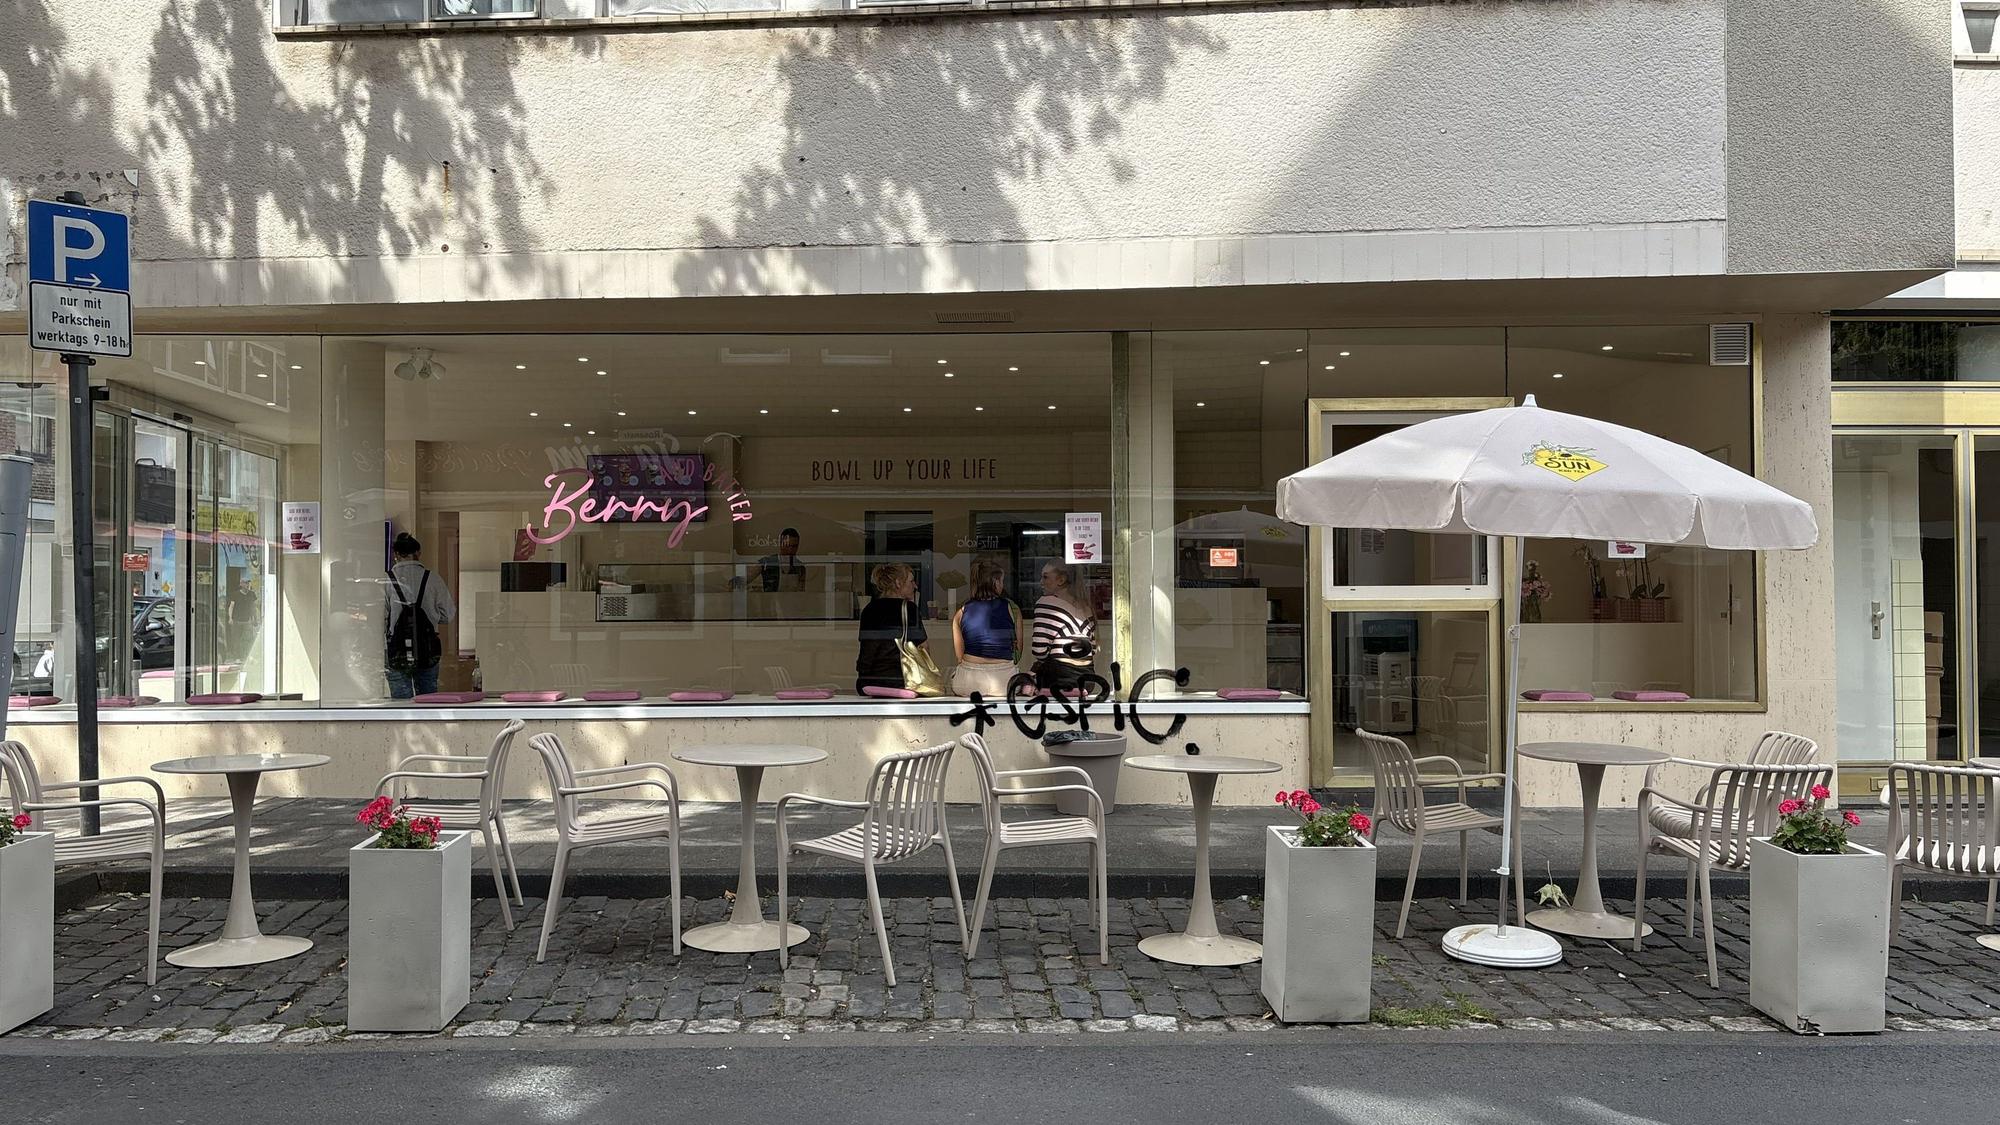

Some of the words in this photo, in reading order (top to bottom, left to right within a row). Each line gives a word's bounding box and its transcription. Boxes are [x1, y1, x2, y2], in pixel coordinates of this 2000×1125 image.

[53, 215, 105, 282] P
[60, 296, 78, 307] nur
[84, 297, 102, 309] mit
[52, 311, 111, 329] Parkschein
[38, 331, 88, 347] werktags
[812, 460, 861, 481] BOWL
[873, 459, 894, 480] UP
[906, 458, 951, 480] YOUR
[963, 458, 997, 480] LIFE
[1544, 456, 1591, 471] SUN
[703, 462, 753, 522] BATTER
[526, 467, 709, 548] Berry
